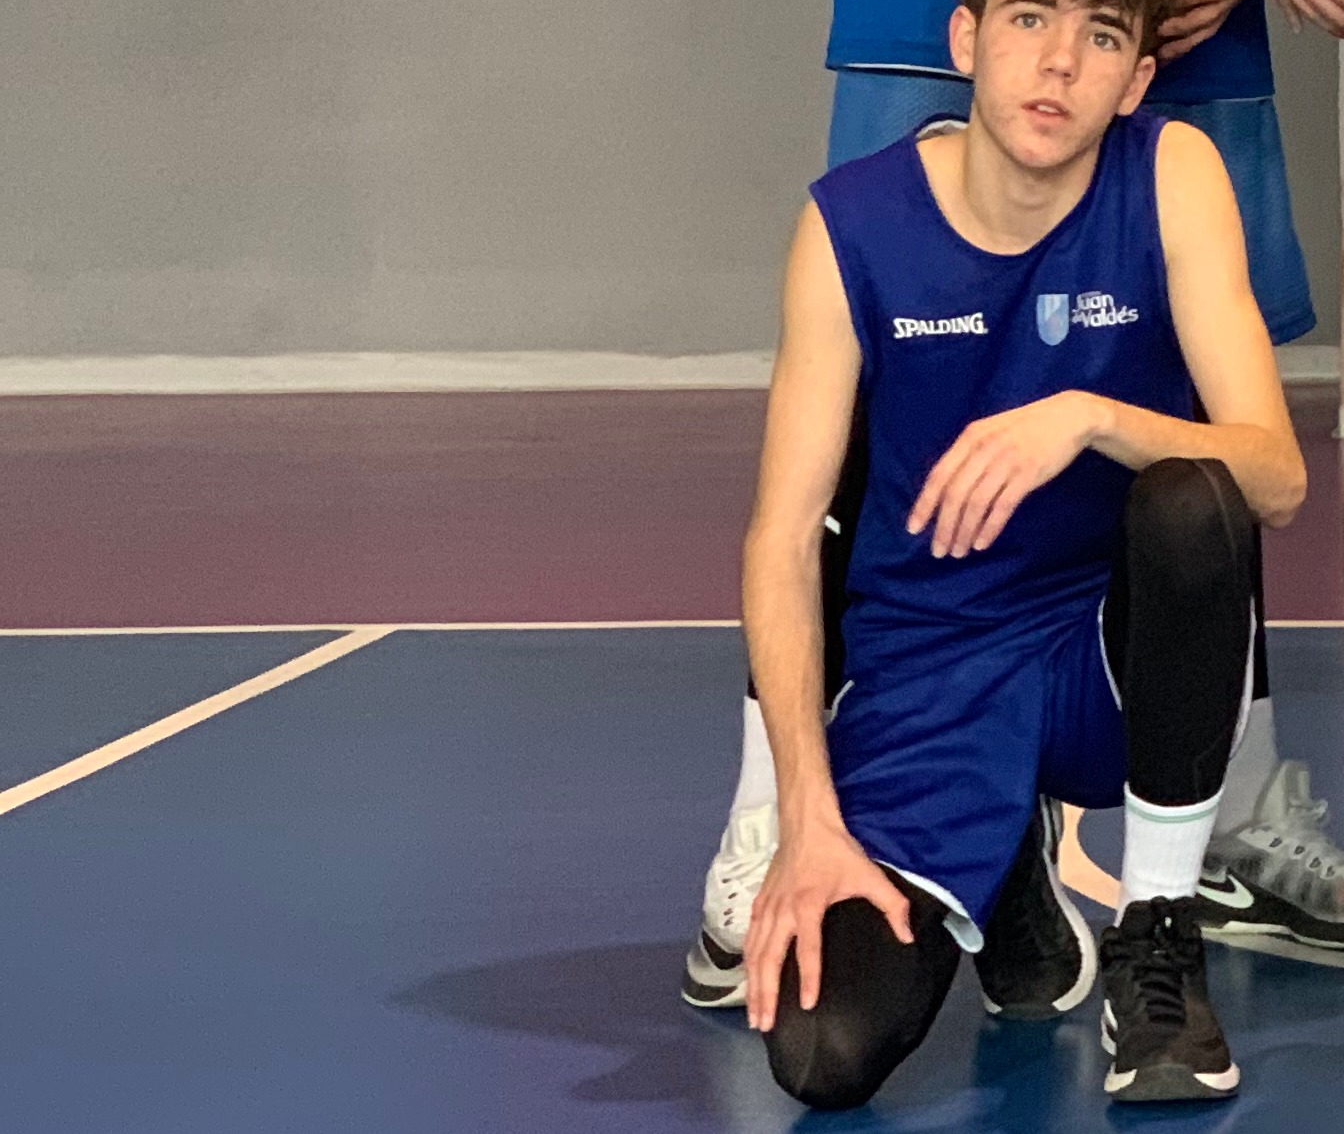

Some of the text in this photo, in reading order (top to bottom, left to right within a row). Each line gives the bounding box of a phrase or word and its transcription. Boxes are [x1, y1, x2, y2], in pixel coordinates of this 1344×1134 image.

[1072, 293, 1115, 312] Juan
[893, 311, 988, 339] SPALDING
[1080, 305, 1140, 328] Valdés
